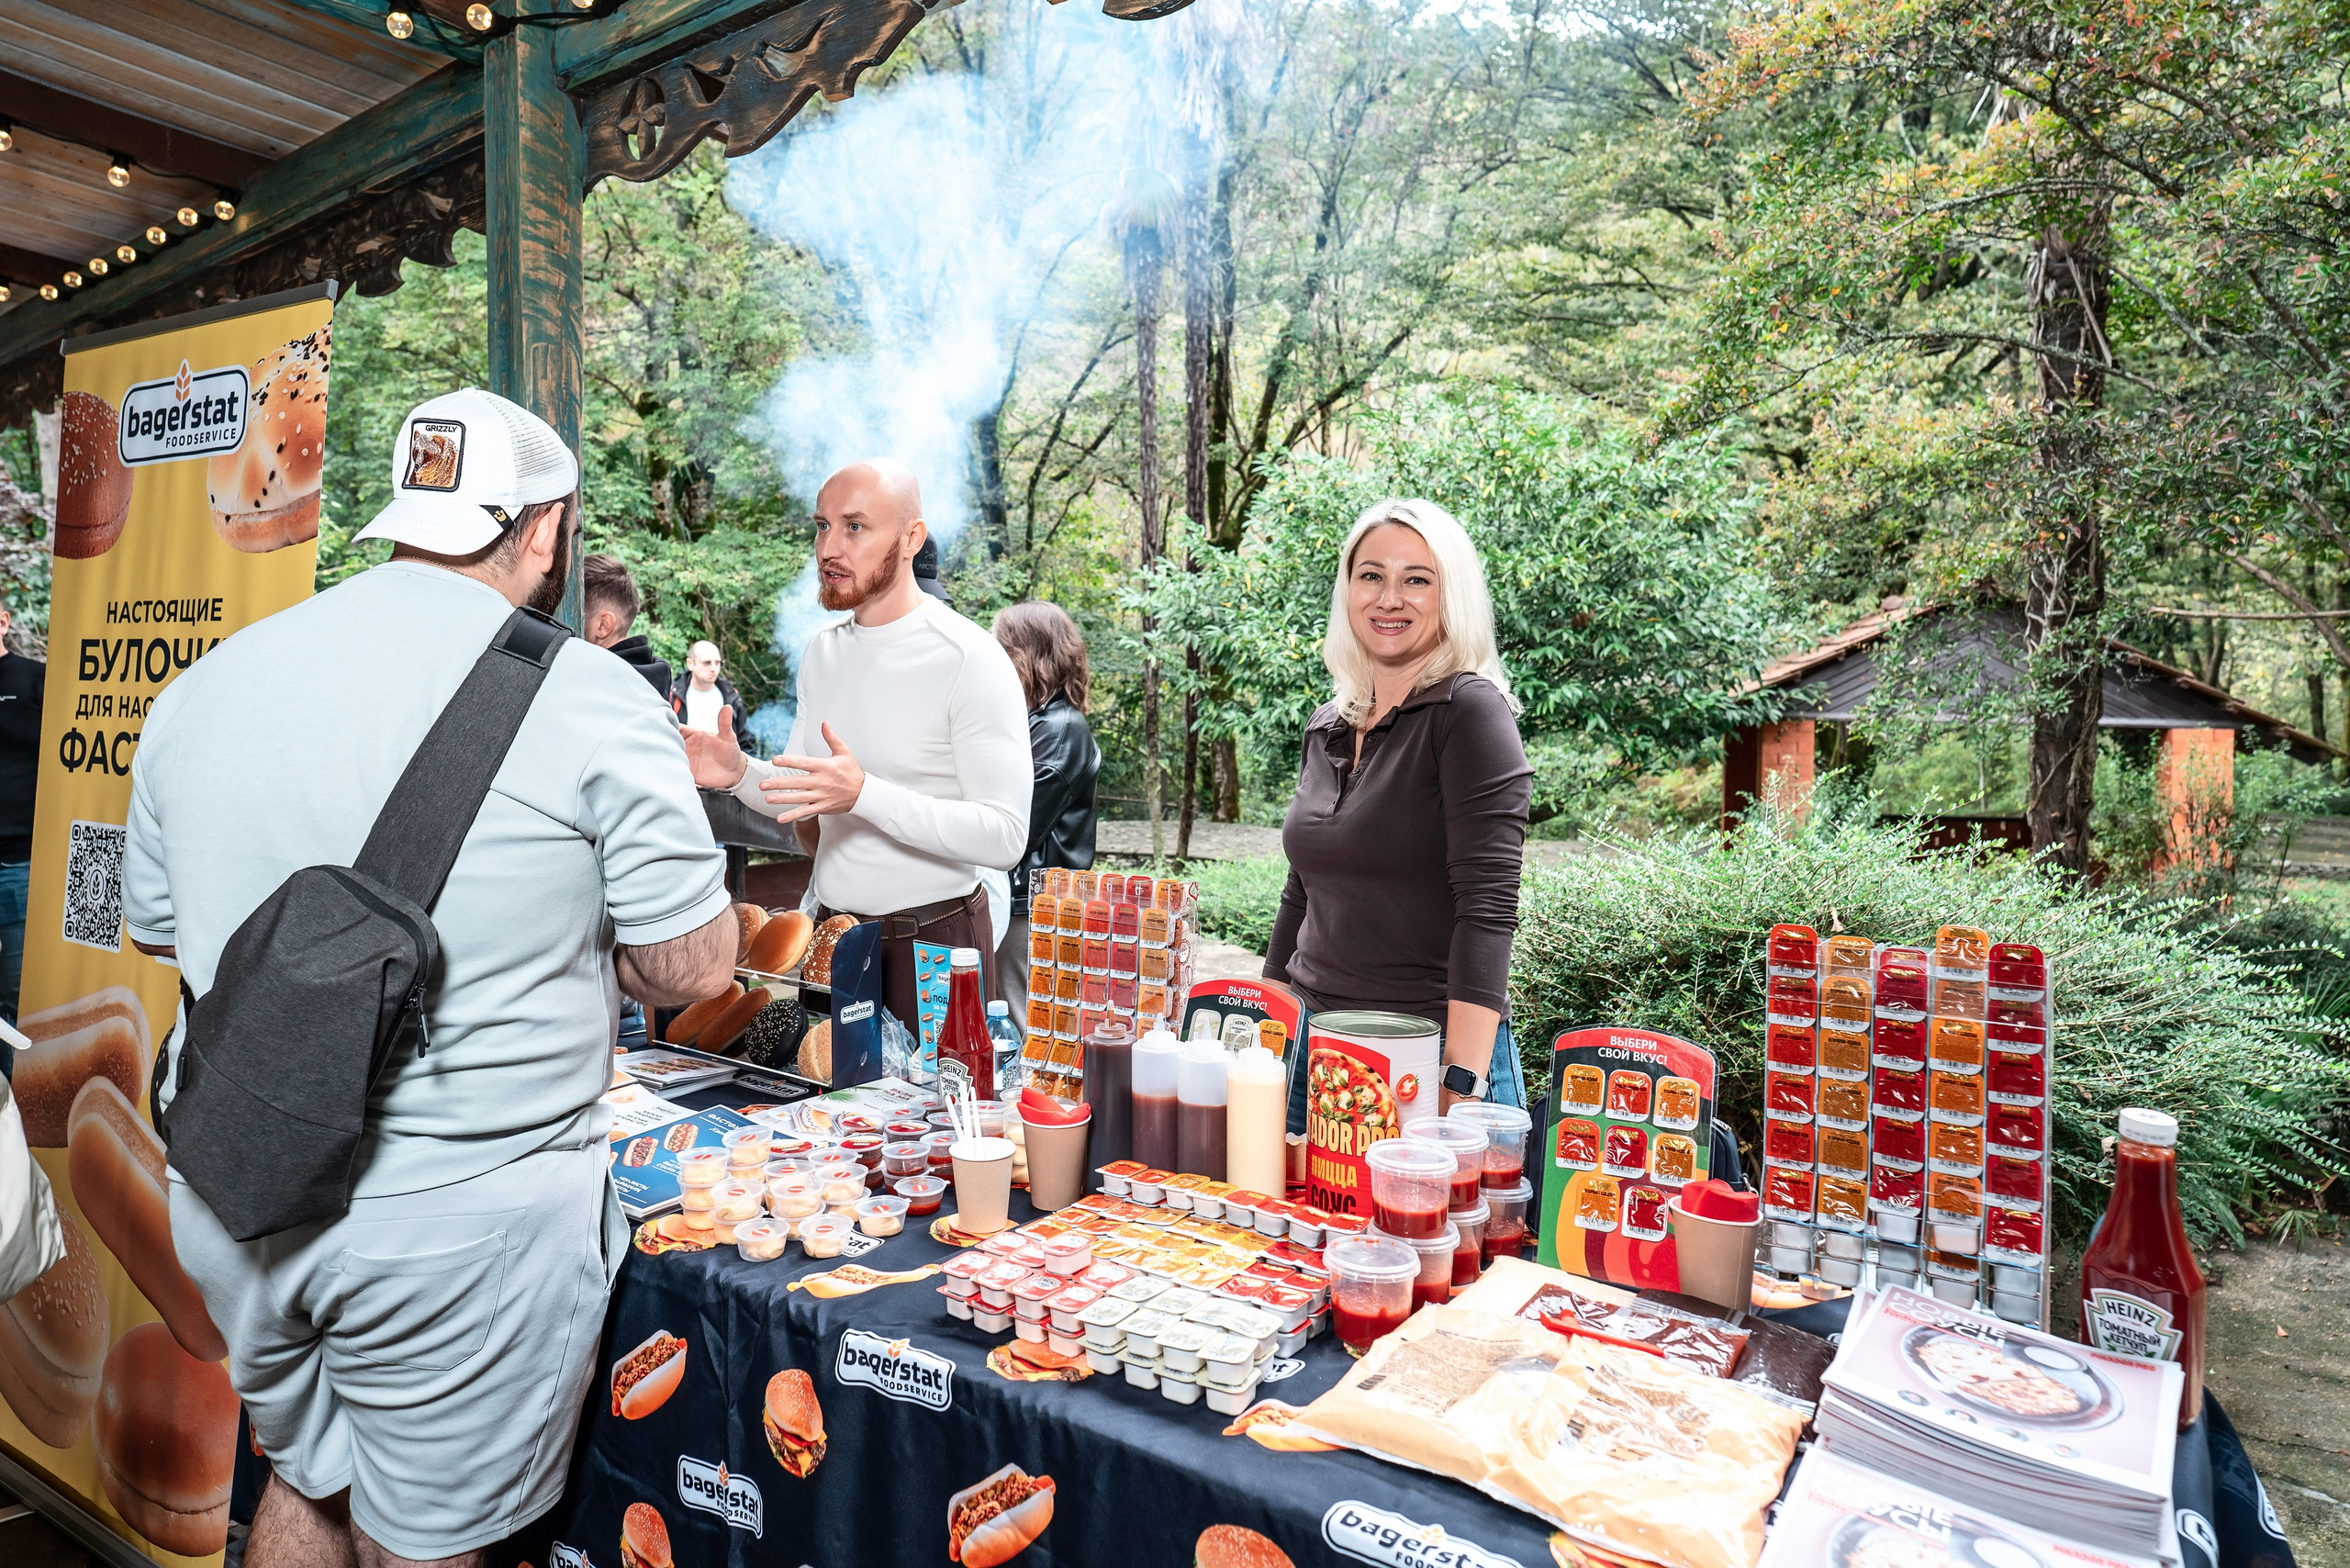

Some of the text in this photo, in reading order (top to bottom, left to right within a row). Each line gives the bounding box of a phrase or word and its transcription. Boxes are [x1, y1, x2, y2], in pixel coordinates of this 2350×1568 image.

[127, 391, 240, 442] bagerstat
[425, 424, 458, 433] GRIZZLY
[165, 428, 237, 449] FOODSERVICE
[106, 598, 224, 626] НАСТОЯЩИЕ
[78, 637, 229, 684] БУЛОЧ
[75, 694, 157, 721] ДЛЯ НАС
[933, 994, 949, 1006] ПОД
[1218, 995, 1268, 1011] СВОЙ ВКУС!
[1227, 985, 1262, 999] ВЫБЕРИ
[843, 1004, 872, 1019] bagerstat
[1597, 1047, 1668, 1065] СВОЙ ВКУС!
[1609, 1036, 1658, 1051] ВЫБЕРИ
[943, 1064, 962, 1077] HEINZ
[890, 1087, 916, 1098] ВКЛЮ
[1311, 1154, 1358, 1189] ПИЦЦА
[1311, 1183, 1357, 1215] СОУС
[1888, 1301, 2006, 1349] СОУСЫ
[1893, 1292, 2009, 1340] НОВЫЕ
[2105, 1301, 2155, 1327] HEINZ
[2098, 1316, 2162, 1348] ТОМАТНЫЙ
[2109, 1333, 2148, 1353] КЕТЧУП
[844, 1341, 943, 1391] bagerstat
[1339, 1510, 1485, 1568] bagerst
